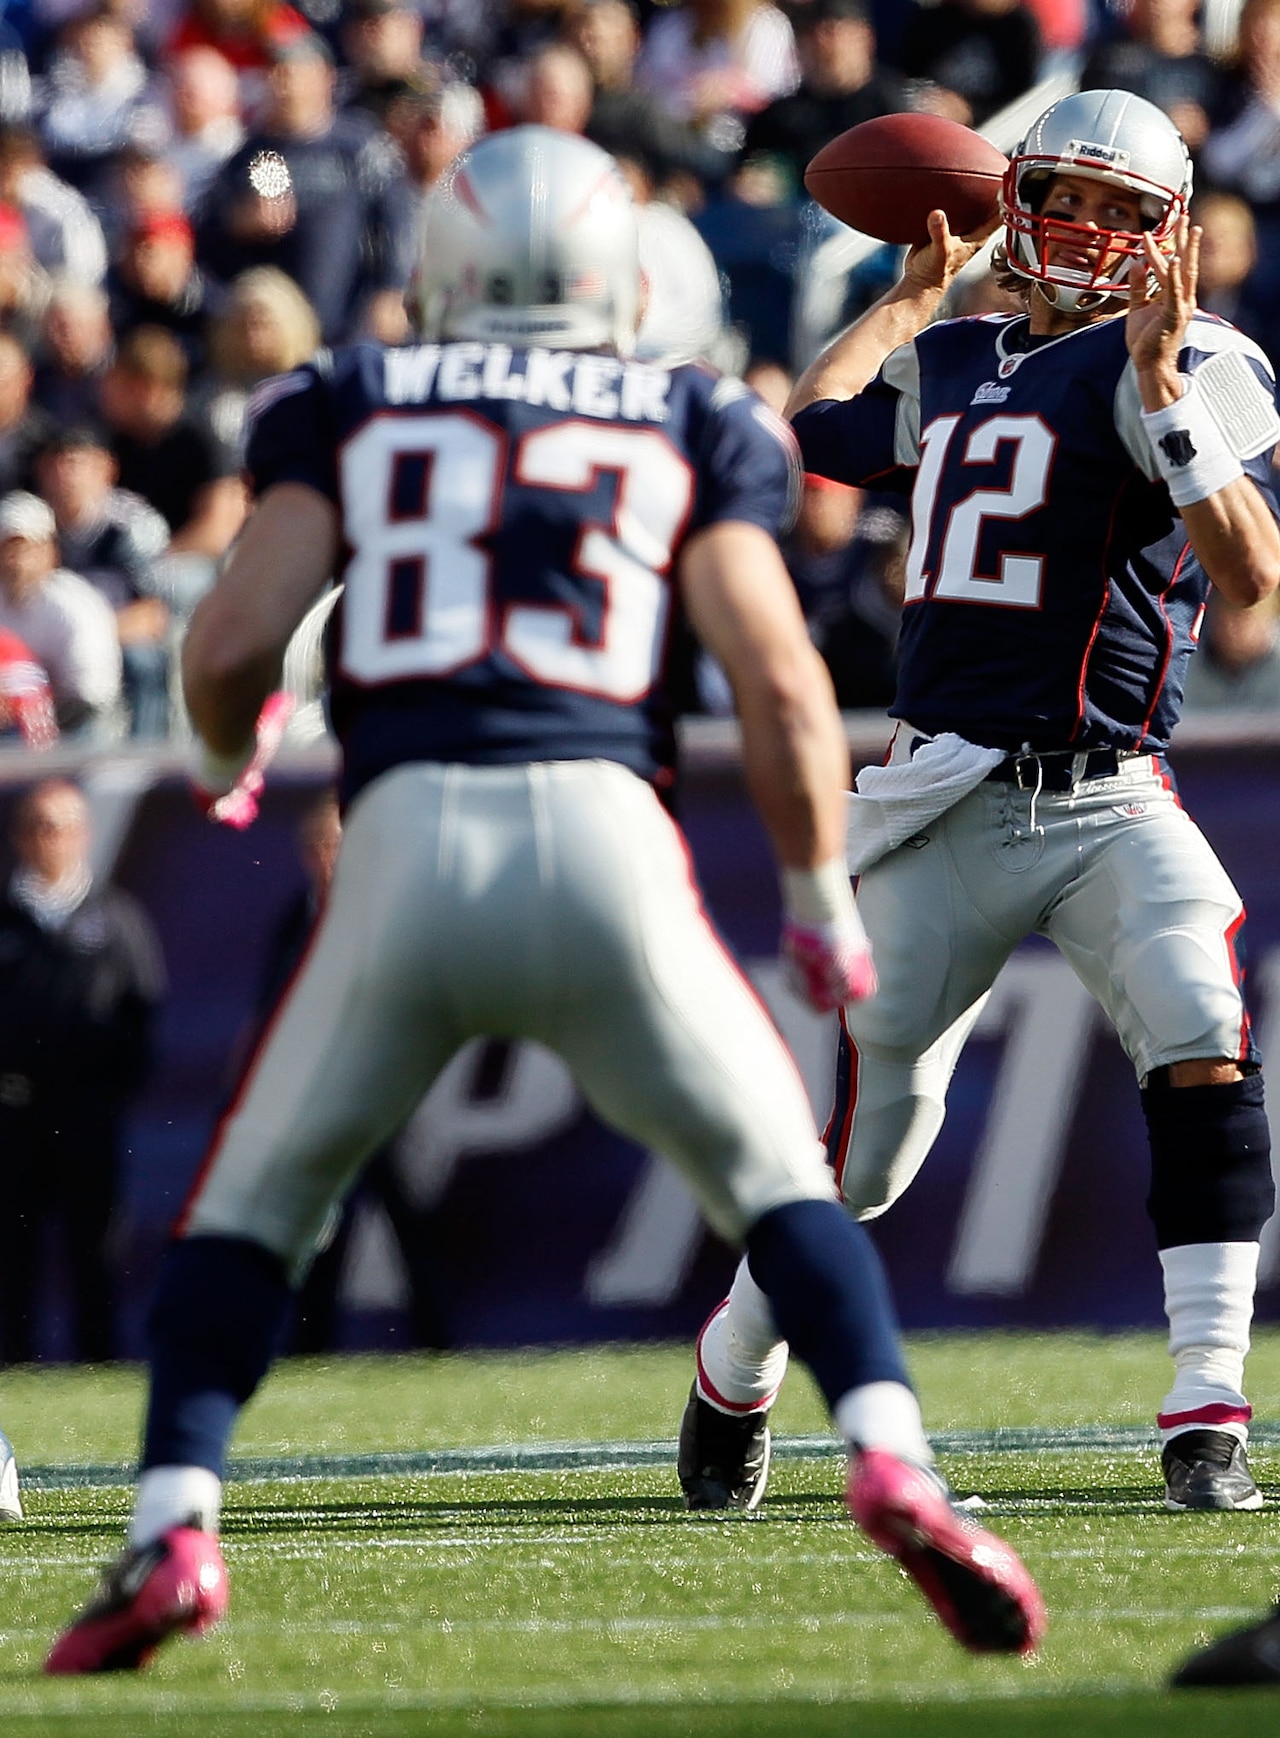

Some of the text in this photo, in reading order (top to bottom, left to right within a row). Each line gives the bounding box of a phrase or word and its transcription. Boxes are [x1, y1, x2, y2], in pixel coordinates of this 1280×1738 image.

[1079, 145, 1116, 161] Riddell
[384, 341, 672, 422] WELKER
[337, 408, 695, 706] 83
[904, 411, 1059, 611] 12
